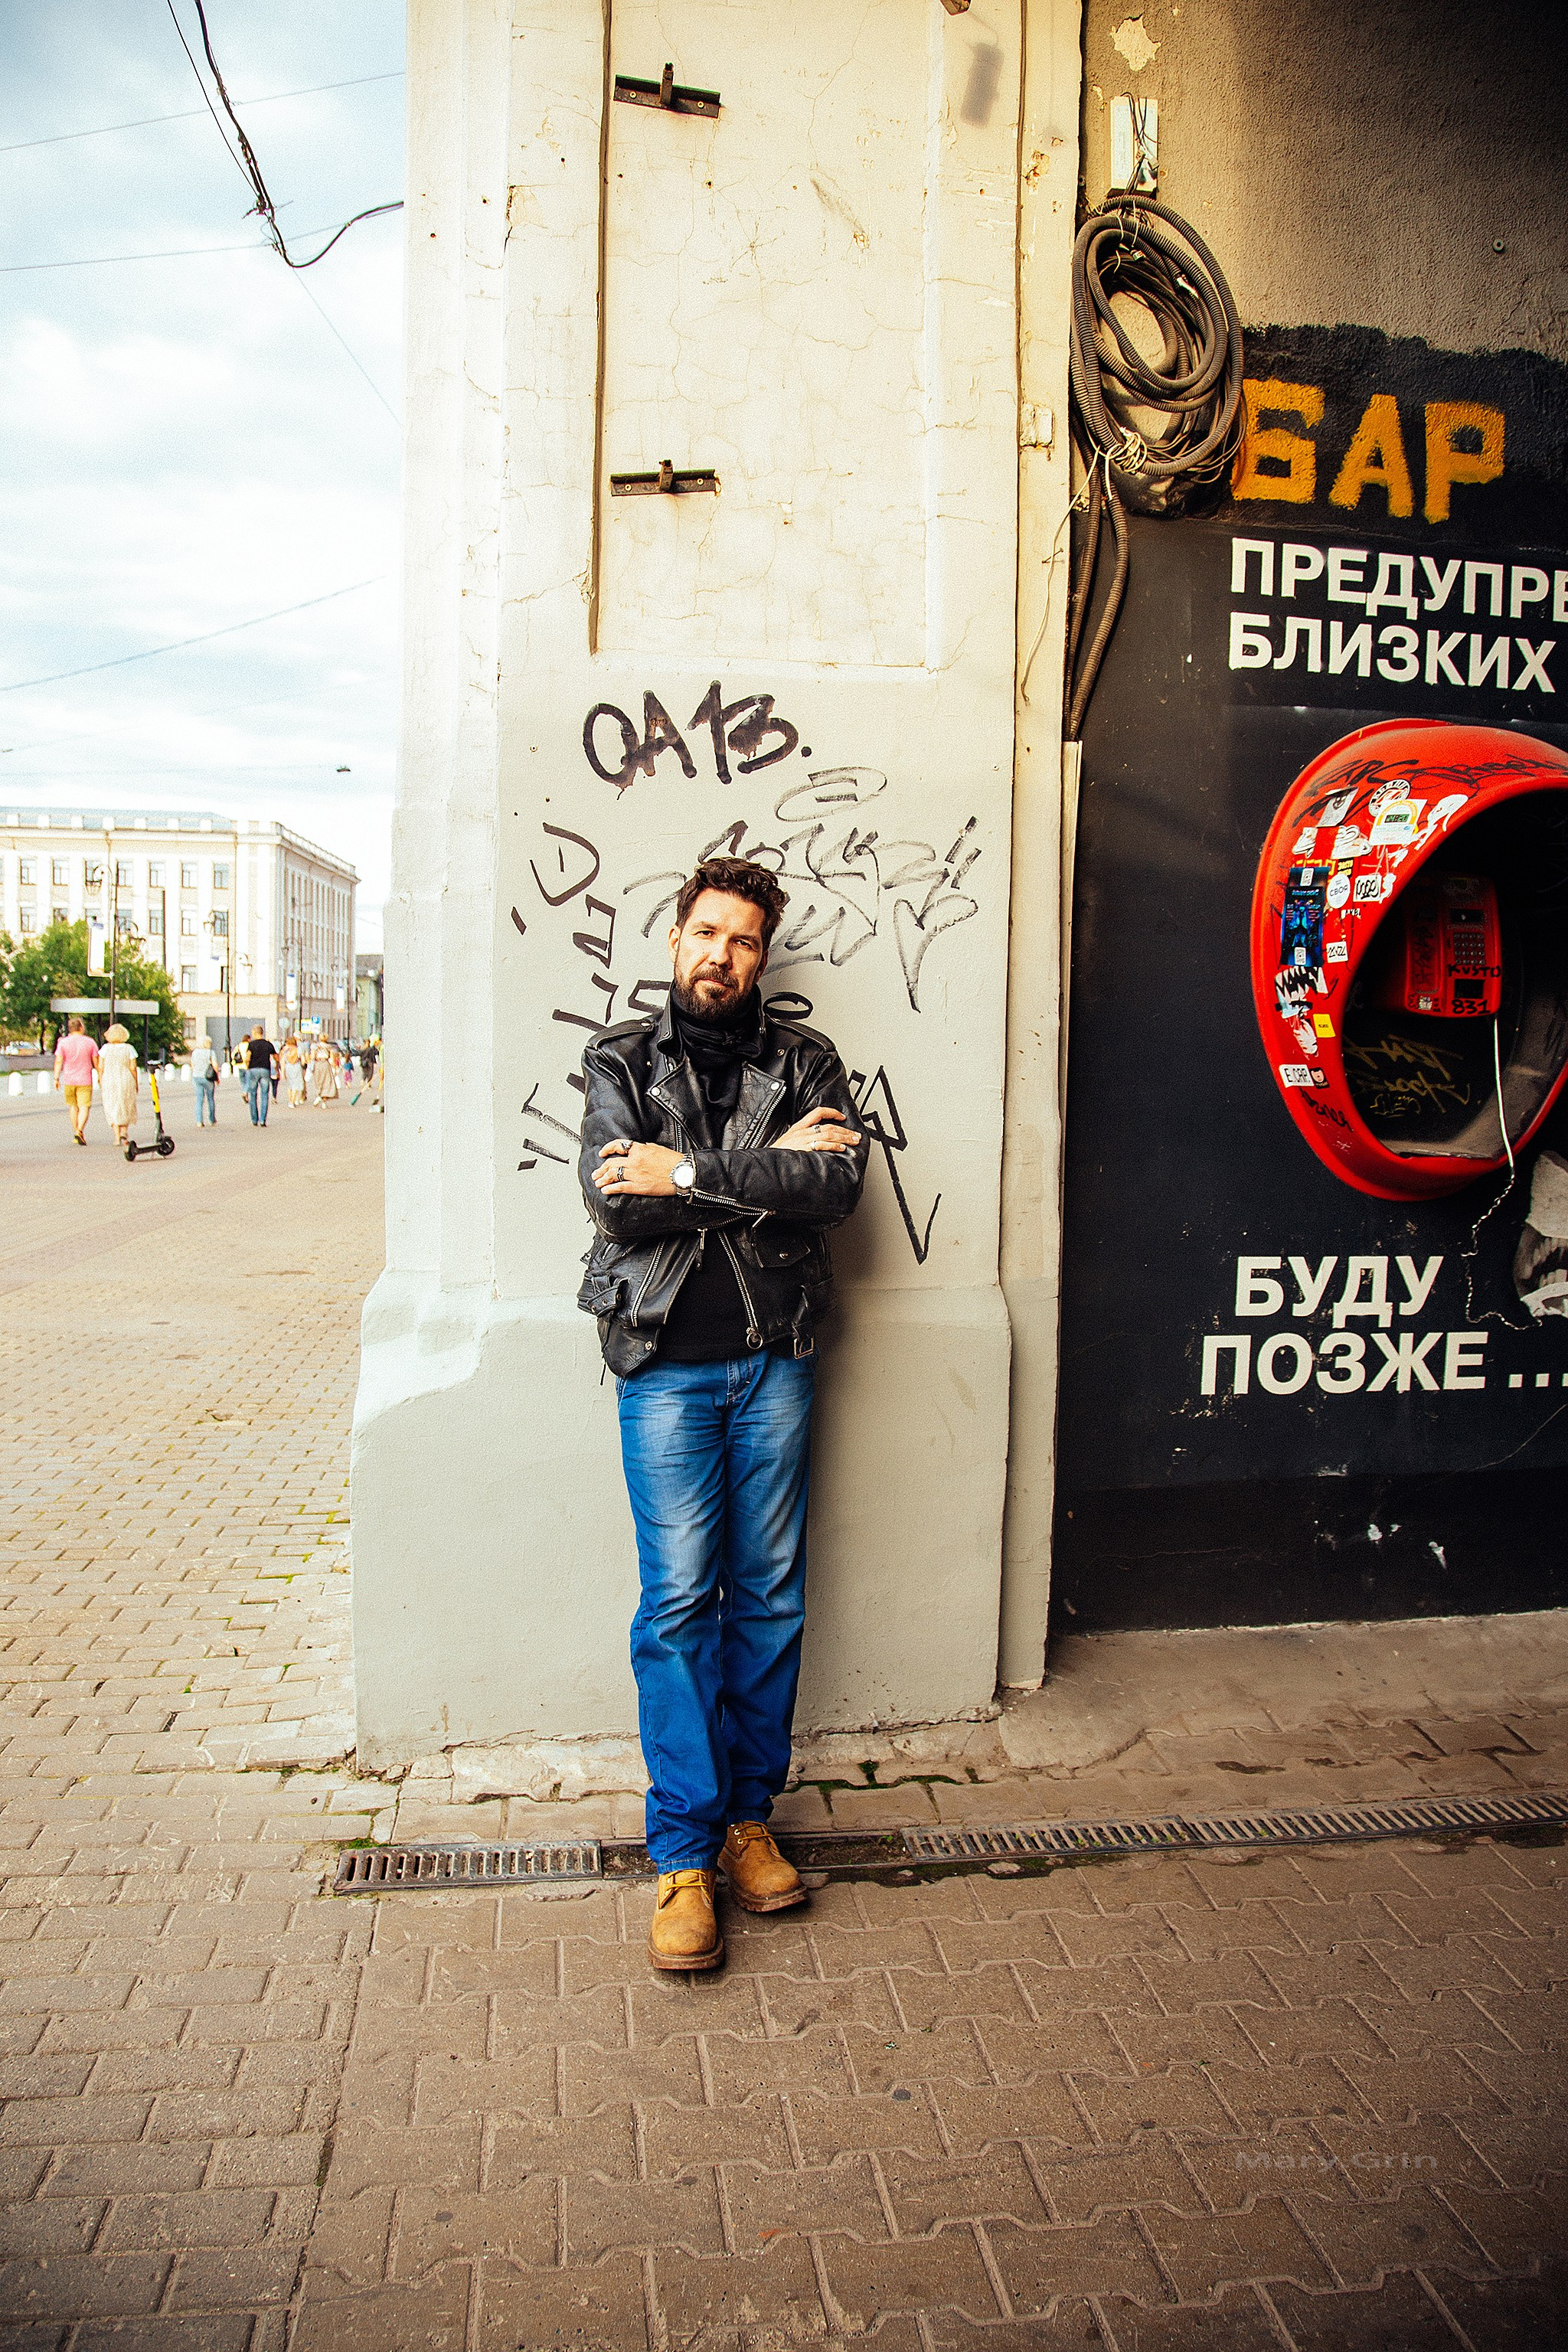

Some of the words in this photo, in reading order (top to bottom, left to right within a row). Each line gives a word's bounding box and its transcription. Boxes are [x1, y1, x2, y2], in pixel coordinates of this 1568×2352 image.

[1230, 378, 1506, 524] БАР
[1228, 612, 1557, 693] БЛИЗКИХ
[1451, 998, 1491, 1014] 831
[1235, 1256, 1444, 1329] БУДУ
